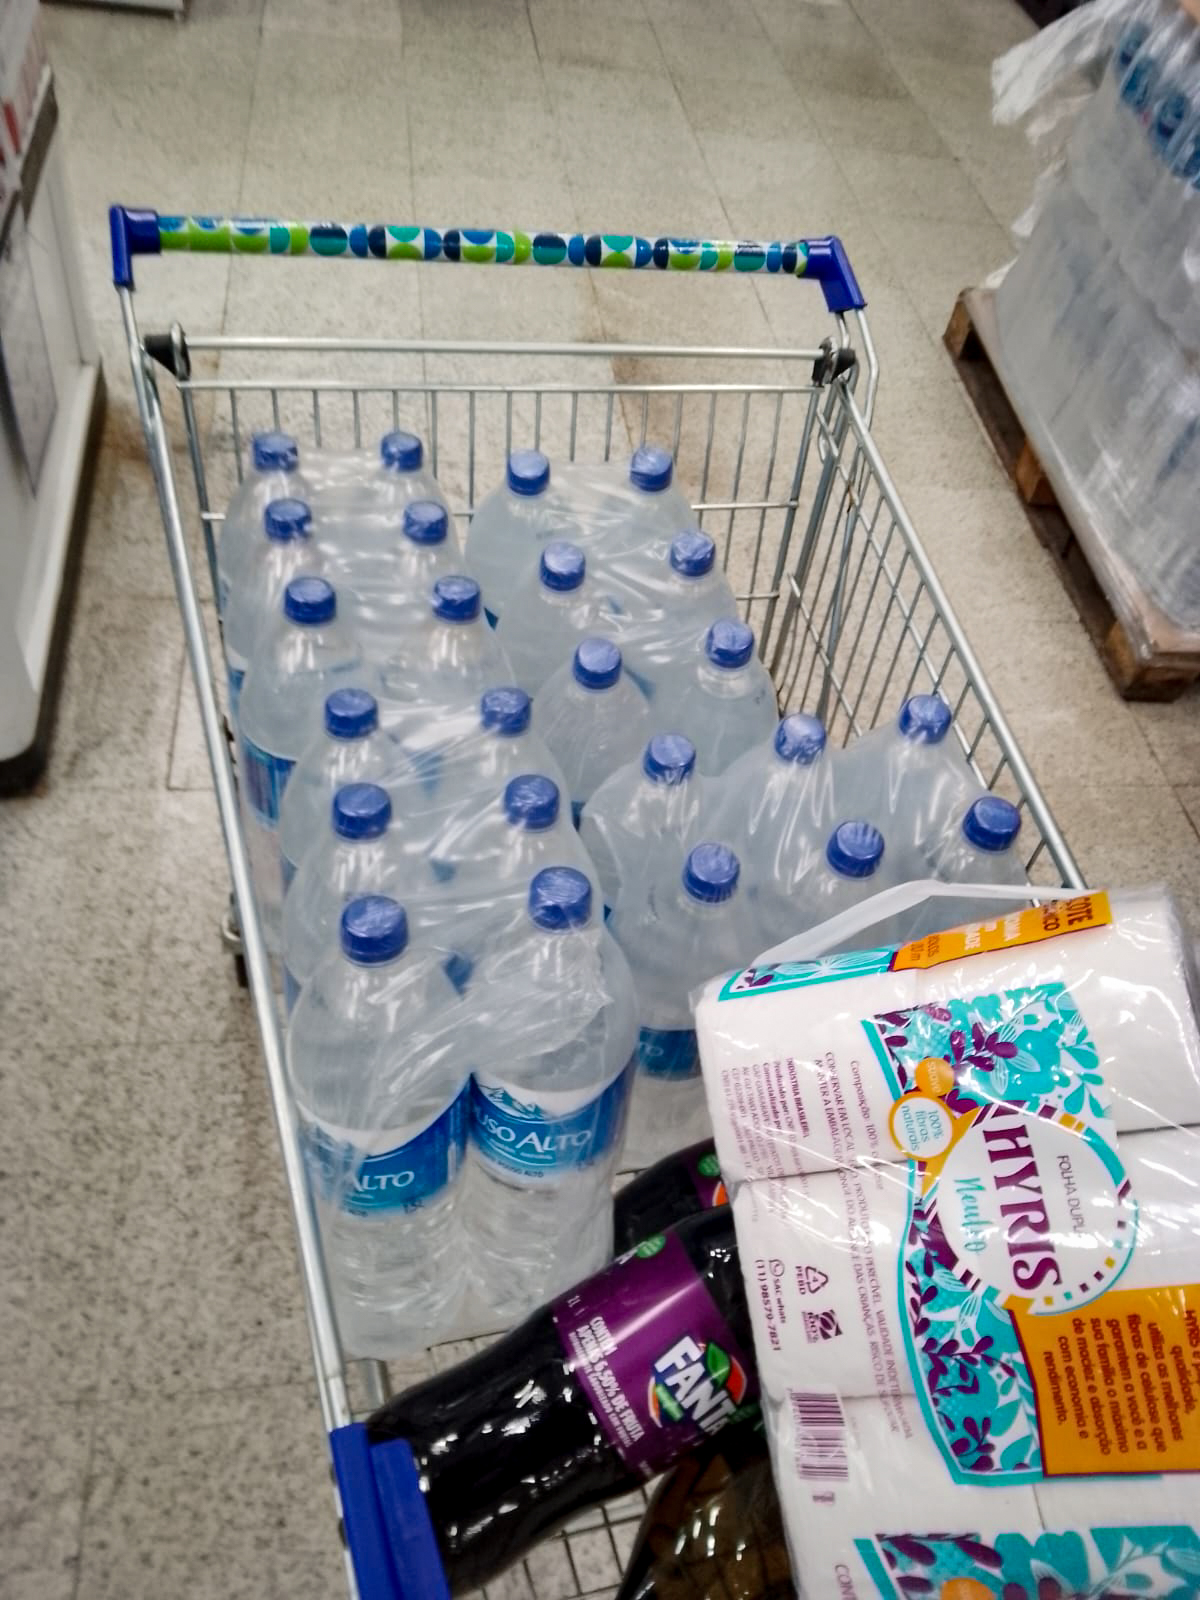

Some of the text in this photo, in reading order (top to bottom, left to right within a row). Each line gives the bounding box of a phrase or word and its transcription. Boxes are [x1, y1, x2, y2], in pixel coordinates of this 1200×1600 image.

[837, 1106, 848, 1121] EM
[901, 1105, 920, 1150] naturais
[916, 1111, 931, 1142] fibras
[928, 1111, 943, 1138] 100%
[515, 1130, 592, 1153] ALTO
[841, 1122, 855, 1151] LOCAL
[814, 1059, 829, 1095] MNTER
[853, 1263, 866, 1284] DAS
[982, 1124, 1061, 1291] HYRIS
[1057, 1155, 1086, 1237] FOLHA DUPL
[754, 1258, 768, 1281] (11)
[794, 1265, 806, 1295] PEBD
[773, 1278, 786, 1323] SAC whats
[575, 1323, 604, 1363] APENAS
[610, 1393, 629, 1412] DE
[1043, 1351, 1068, 1424] rendimento.
[1058, 1336, 1089, 1439] com economia e
[1072, 1318, 1113, 1455] de maciez e absorção
[1091, 1318, 1131, 1452] sua família o máximo
[1107, 1318, 1147, 1450] garantem a você e a
[1127, 1314, 1166, 1452] fibras de celulose que
[1148, 1322, 1184, 1440] utiliza as melhores
[618, 1407, 646, 1442] FRUTA
